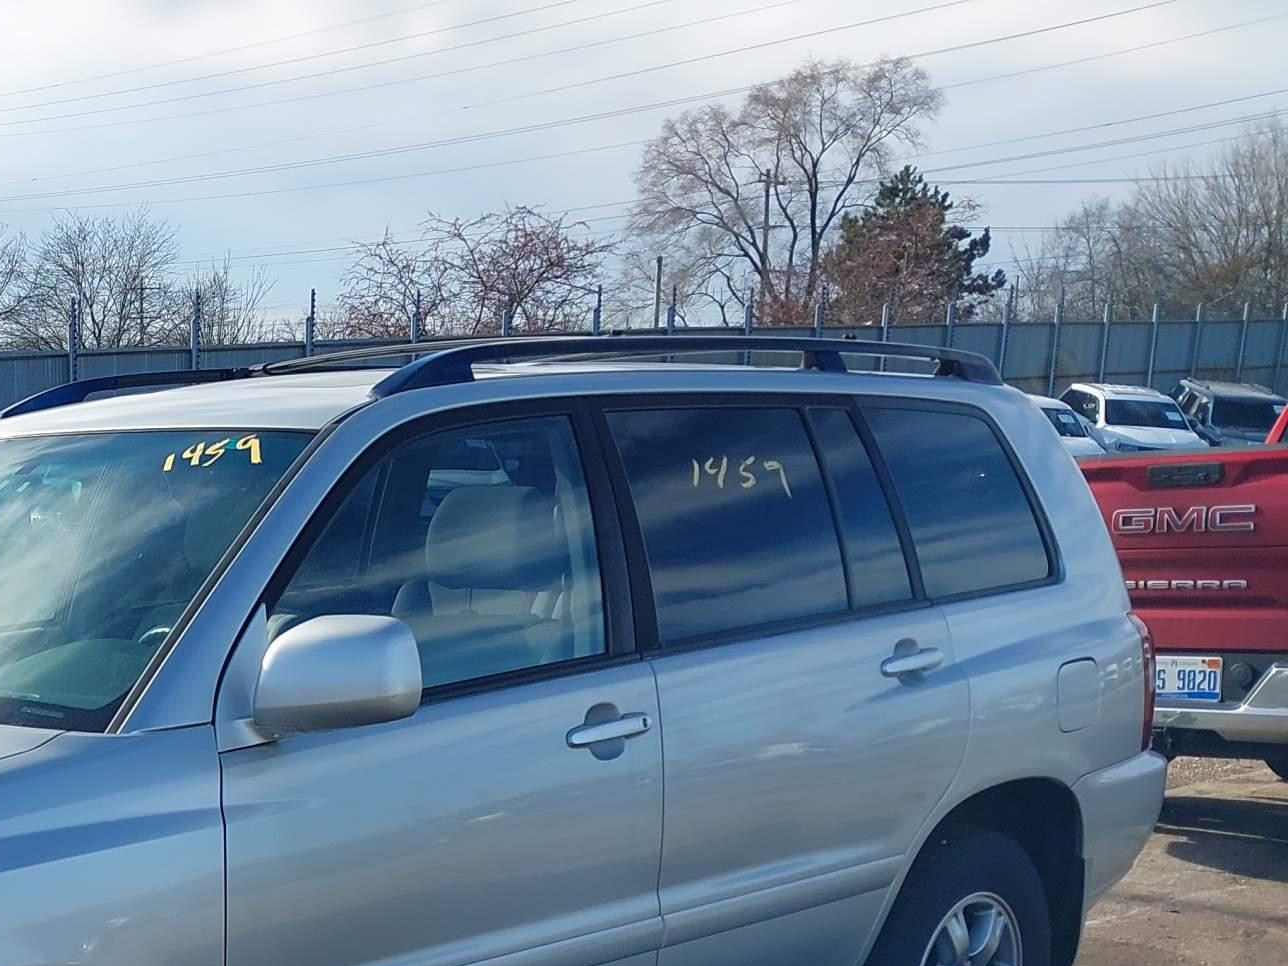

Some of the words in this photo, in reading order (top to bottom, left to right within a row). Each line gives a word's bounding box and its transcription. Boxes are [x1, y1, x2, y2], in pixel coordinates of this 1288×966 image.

[162, 433, 263, 472] 1459
[692, 455, 792, 499] 1459
[1111, 503, 1257, 535] GMC
[1177, 669, 1217, 692] 9820
